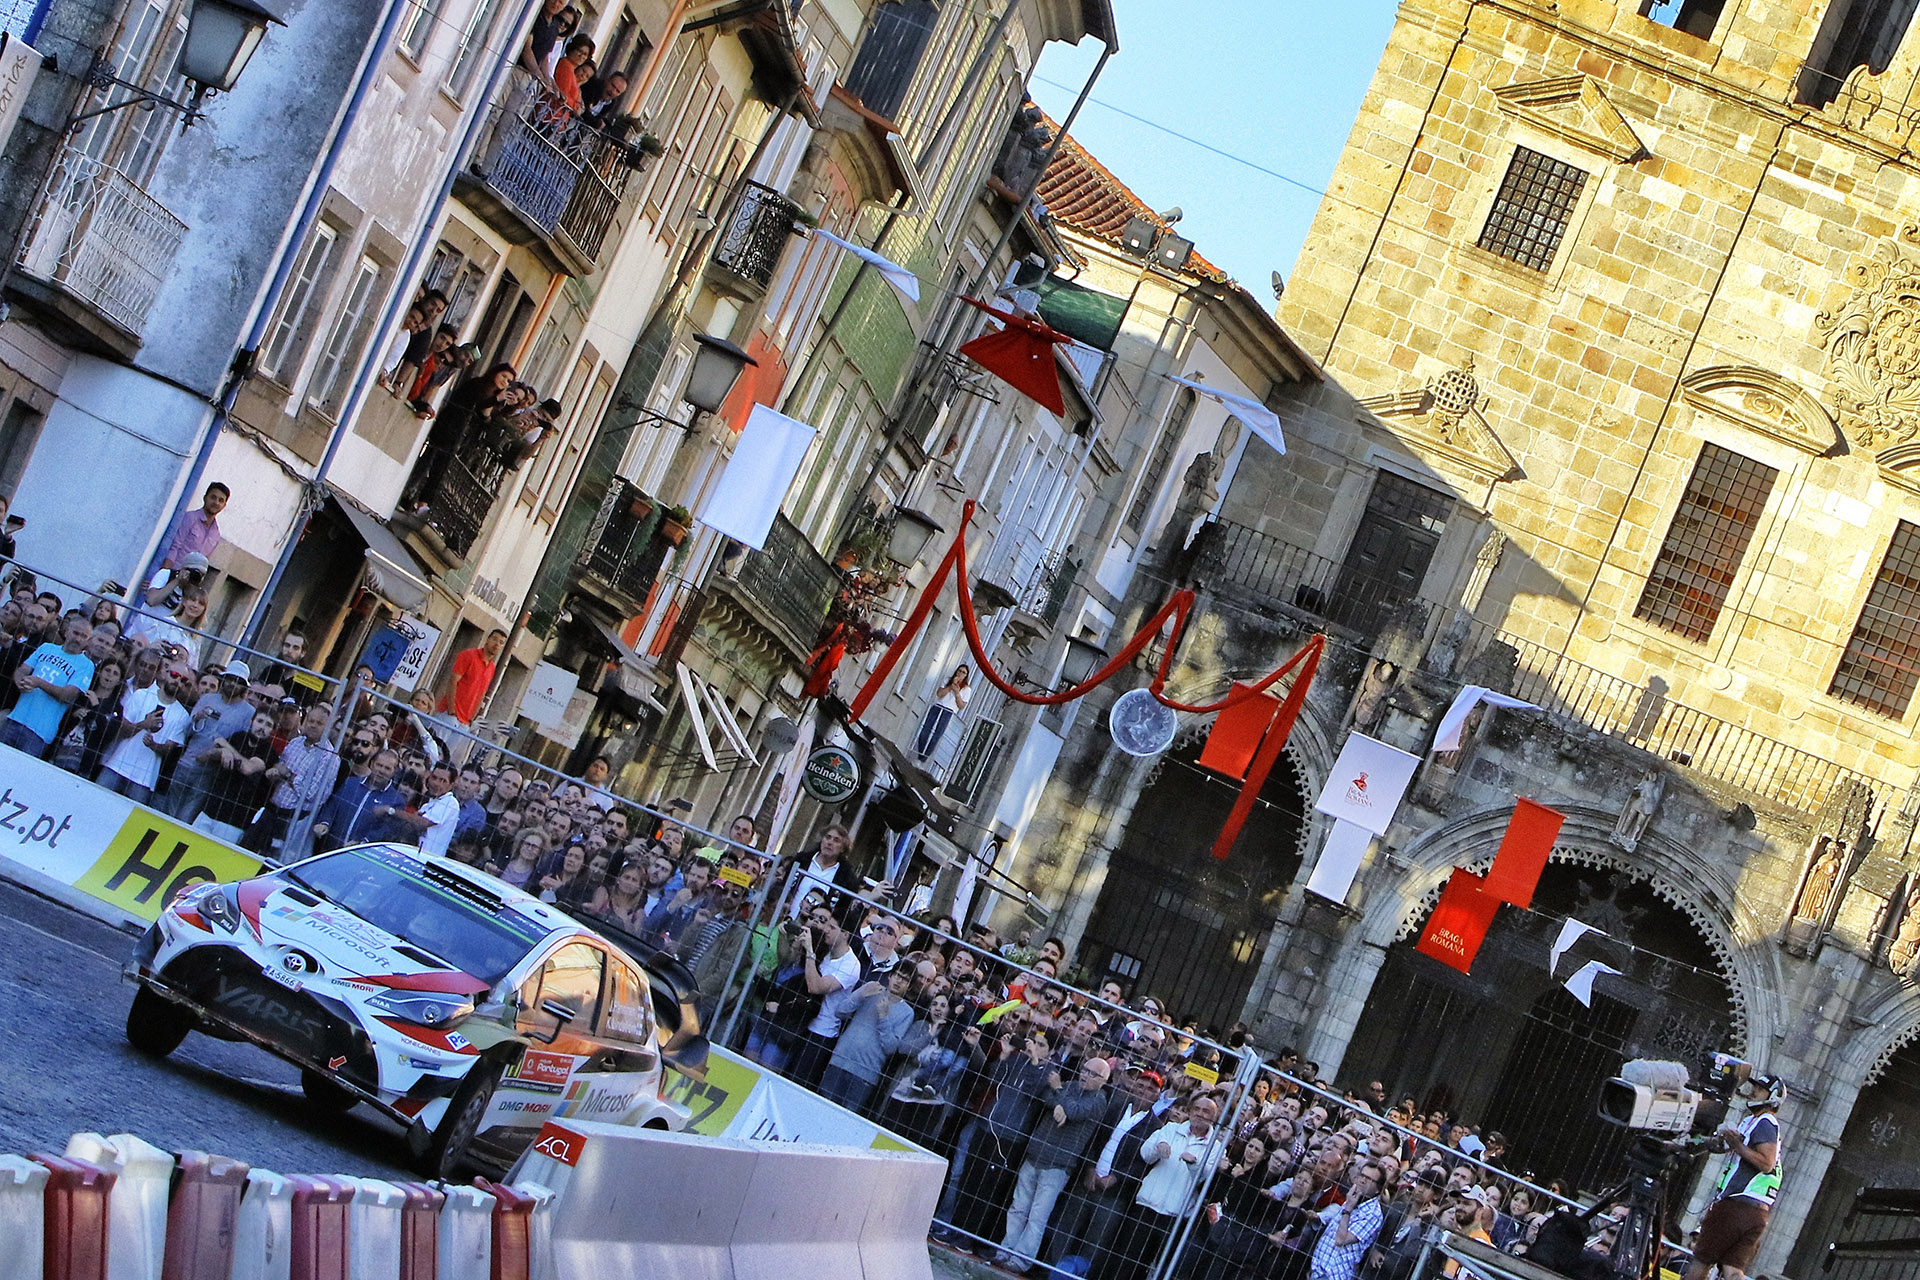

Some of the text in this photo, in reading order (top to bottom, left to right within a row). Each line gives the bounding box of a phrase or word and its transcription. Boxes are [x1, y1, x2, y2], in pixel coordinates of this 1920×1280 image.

[807, 761, 853, 788] Heineken
[305, 919, 391, 968] Microsoft
[1430, 932, 1465, 956] ROMANA
[1438, 927, 1464, 946] BRAGA
[331, 978, 375, 993] DMG MORI
[371, 997, 392, 1009] PIAA
[536, 1062, 570, 1076] Portugal
[498, 1101, 552, 1113] DMG MORI
[535, 1136, 570, 1162] ACL
